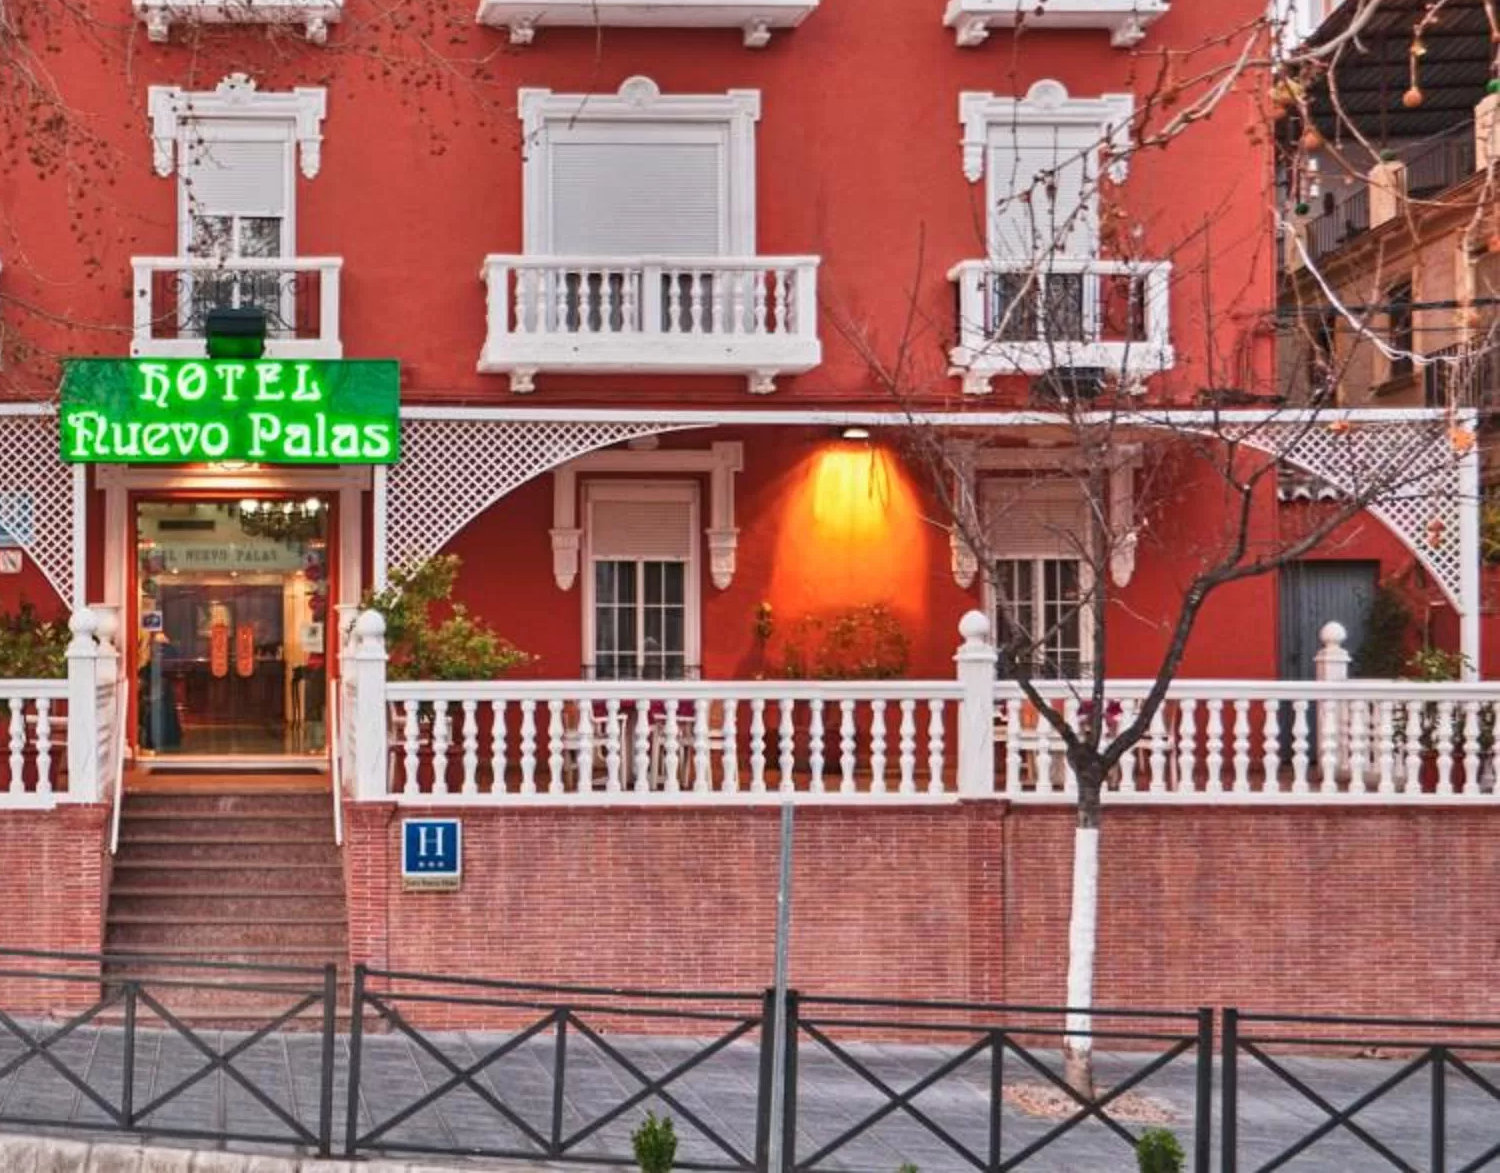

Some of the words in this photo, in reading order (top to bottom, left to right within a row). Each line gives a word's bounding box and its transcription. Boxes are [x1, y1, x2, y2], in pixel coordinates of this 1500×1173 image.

[138, 362, 322, 408] HOTEL
[67, 410, 230, 457] Nuevo
[247, 411, 391, 458] Palas
[418, 826, 445, 857] H
